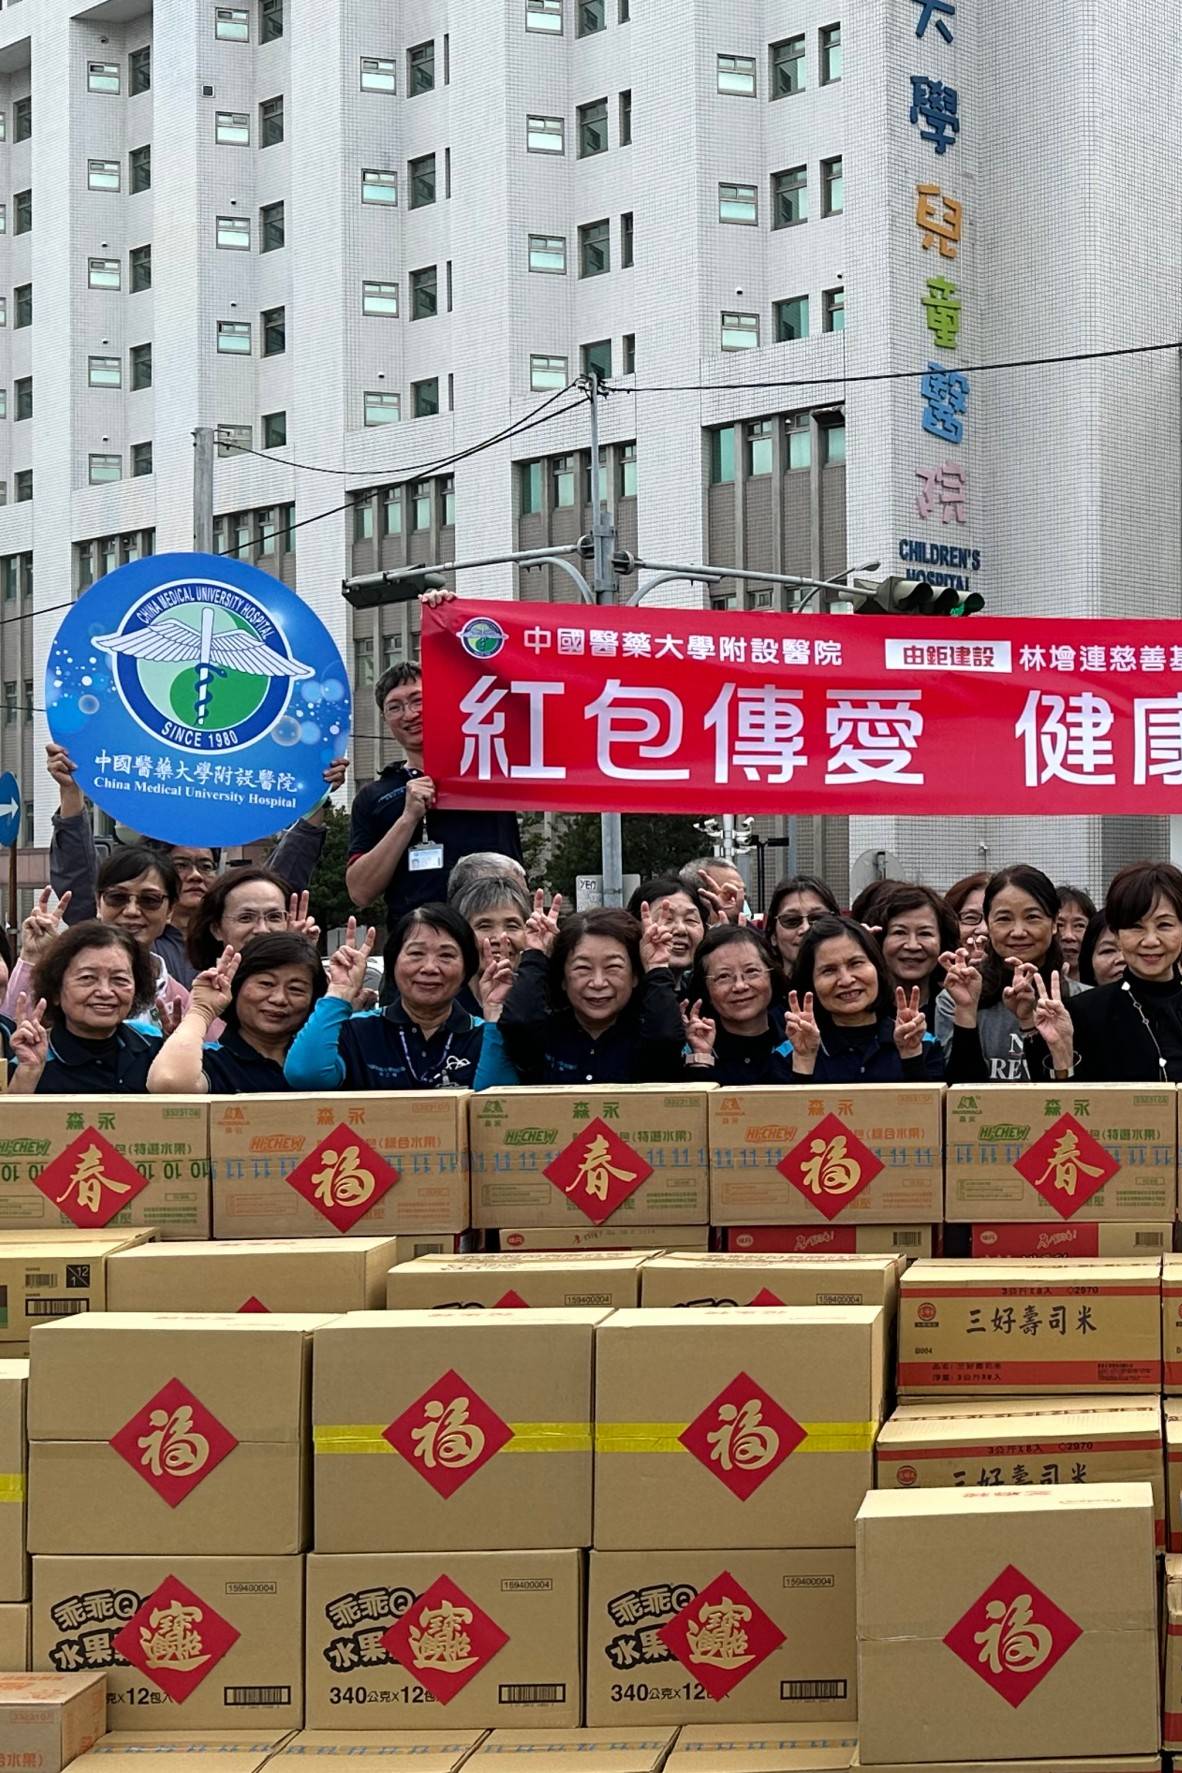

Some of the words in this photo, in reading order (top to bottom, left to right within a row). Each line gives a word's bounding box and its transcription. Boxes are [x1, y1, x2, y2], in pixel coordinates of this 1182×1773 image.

[899, 538, 981, 571] CHILDREN'S
[136, 602, 160, 624] CHINA
[160, 587, 195, 609] MEDICAL
[196, 585, 243, 610] UNIVERSITY
[240, 603, 275, 640] HOSPITAL
[522, 625, 842, 667] 中國醫藥大學附設醫院
[902, 643, 994, 669] 由鉅建設
[161, 721, 202, 749] SINCE
[208, 730, 238, 749] 1980
[458, 674, 925, 786] 紅包傳愛
[94, 749, 297, 793] 中國醫藥大學附設醫院
[94, 777, 131, 791] China
[134, 781, 182, 797] Medical
[185, 785, 244, 806] University
[248, 792, 296, 809] Hospital
[978, 1124, 1031, 1142] HI-CHEW
[1034, 1129, 1105, 1196] 春
[56, 1144, 131, 1213] 春
[311, 1145, 376, 1208] 福
[565, 1134, 638, 1201] 春
[800, 1135, 862, 1195] 福
[966, 1304, 1096, 1336] 三好壽司米
[138, 1405, 209, 1476] 福
[411, 1397, 485, 1469] 福
[706, 1399, 780, 1471] 福
[973, 1593, 1054, 1674] 福
